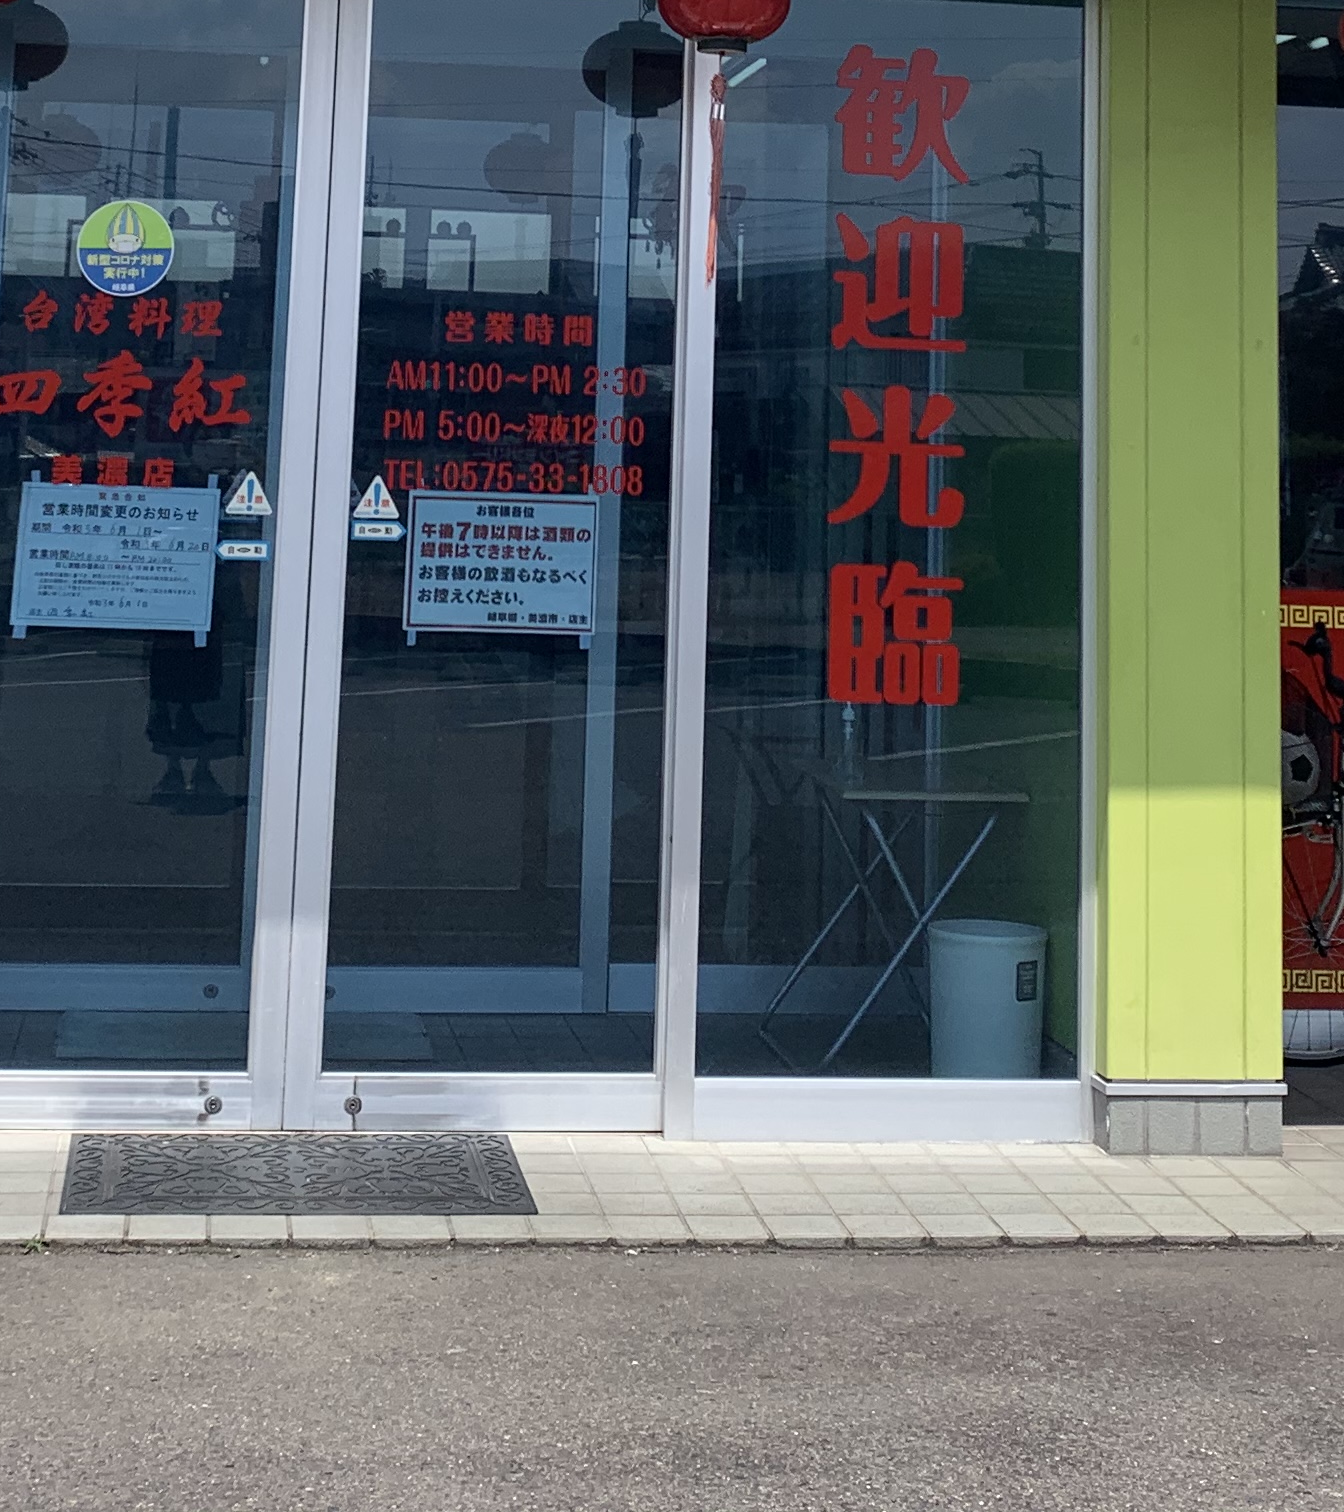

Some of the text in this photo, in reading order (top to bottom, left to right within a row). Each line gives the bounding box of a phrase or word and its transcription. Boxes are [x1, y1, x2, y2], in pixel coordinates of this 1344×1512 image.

[87, 254, 164, 266] 新型コロナ対策
[23, 290, 224, 339] 台湾料理
[445, 311, 594, 346] 営業時間
[827, 44, 970, 706] 歓迎光臨
[383, 409, 424, 441] PM
[51, 453, 174, 488] 美濃店
[384, 459, 643, 496] TEL:0575-33-1808
[42, 503, 199, 521] 営業時間変更のお知らせ
[476, 505, 534, 518] お客様各位
[422, 522, 591, 543] 午後7時以降は酒類の
[420, 542, 553, 561] 提供はできません。
[418, 565, 587, 584] お客様の飲酒もなるべく
[418, 588, 524, 605] お控えください。
